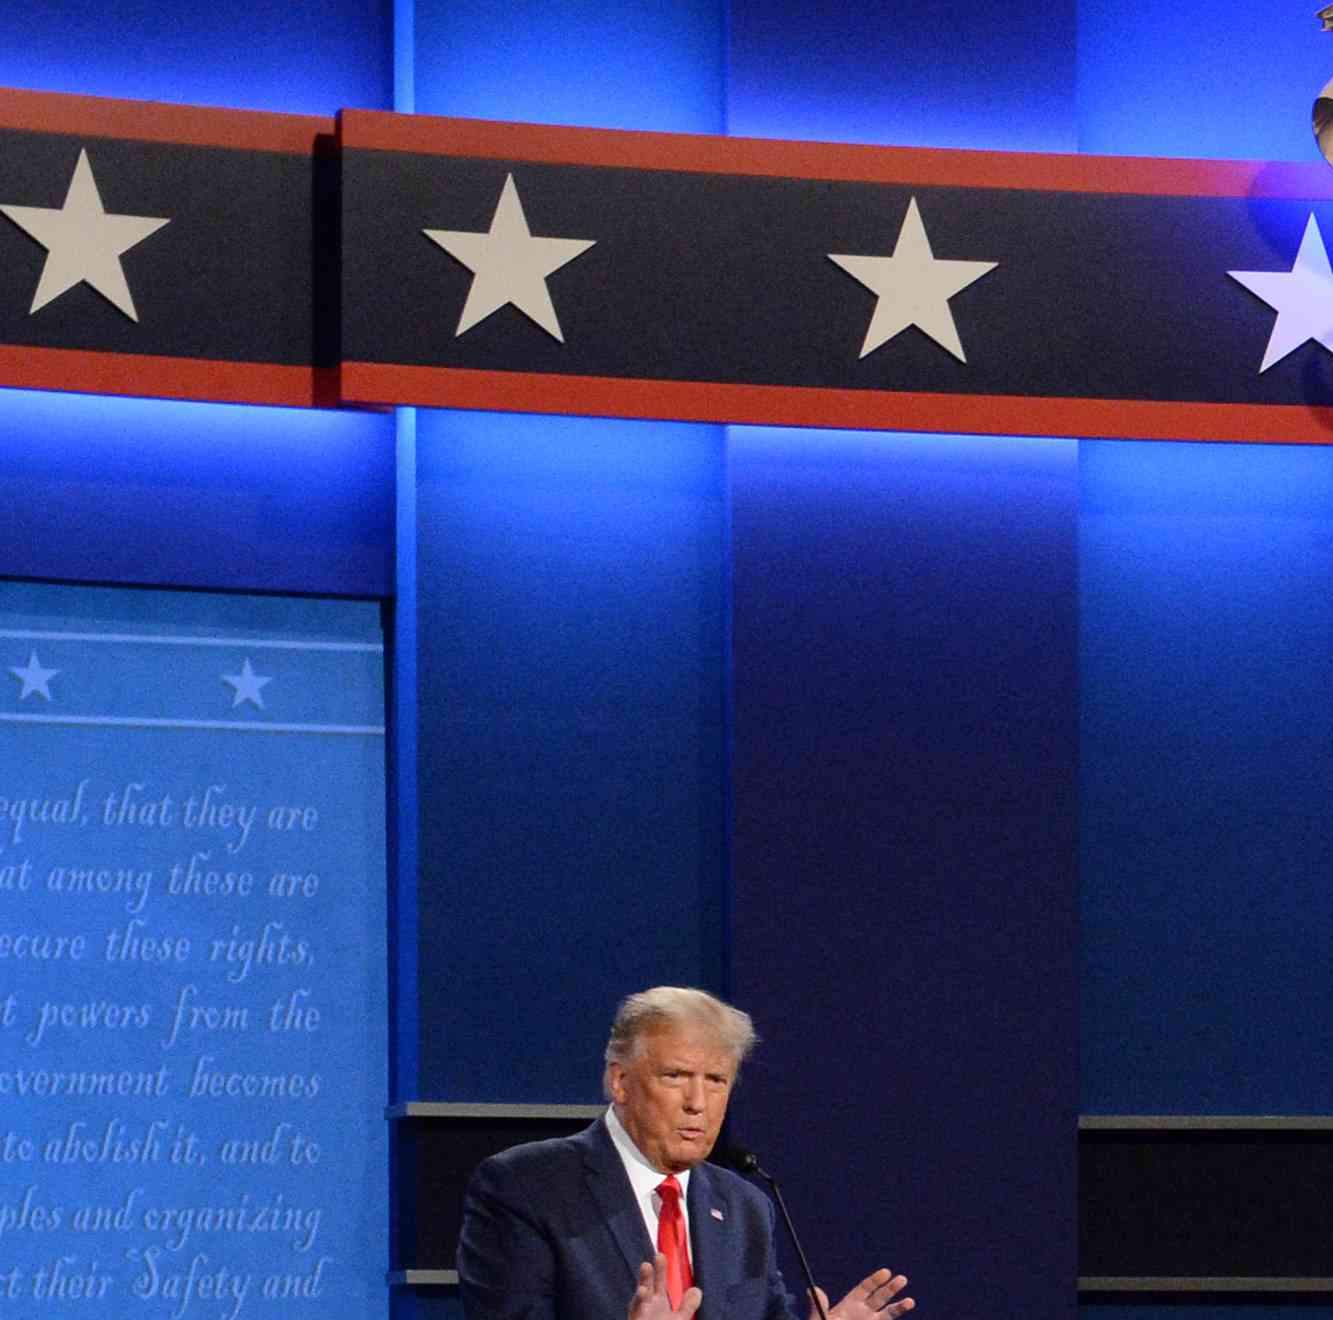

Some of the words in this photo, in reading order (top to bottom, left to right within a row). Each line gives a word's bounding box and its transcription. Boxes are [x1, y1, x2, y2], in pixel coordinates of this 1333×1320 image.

[103, 783, 176, 826] that
[183, 784, 257, 855] they
[267, 804, 319, 831] are
[47, 866, 152, 914] among
[168, 849, 253, 897] these
[268, 872, 319, 897] are
[105, 918, 192, 962] these
[209, 922, 315, 983] rights,
[26, 1000, 150, 1047] powers
[161, 984, 249, 1050] from
[269, 988, 321, 1033] the
[190, 1055, 322, 1098] becomes
[3, 1130, 34, 1163] to
[44, 1118, 169, 1164] abolish
[170, 1126, 207, 1168] it,
[220, 1122, 293, 1164] and
[289, 1132, 321, 1164] to
[72, 1187, 145, 1232] and
[143, 1193, 322, 1251] organizing
[32, 1256, 113, 1300] their
[261, 1255, 333, 1299] and
